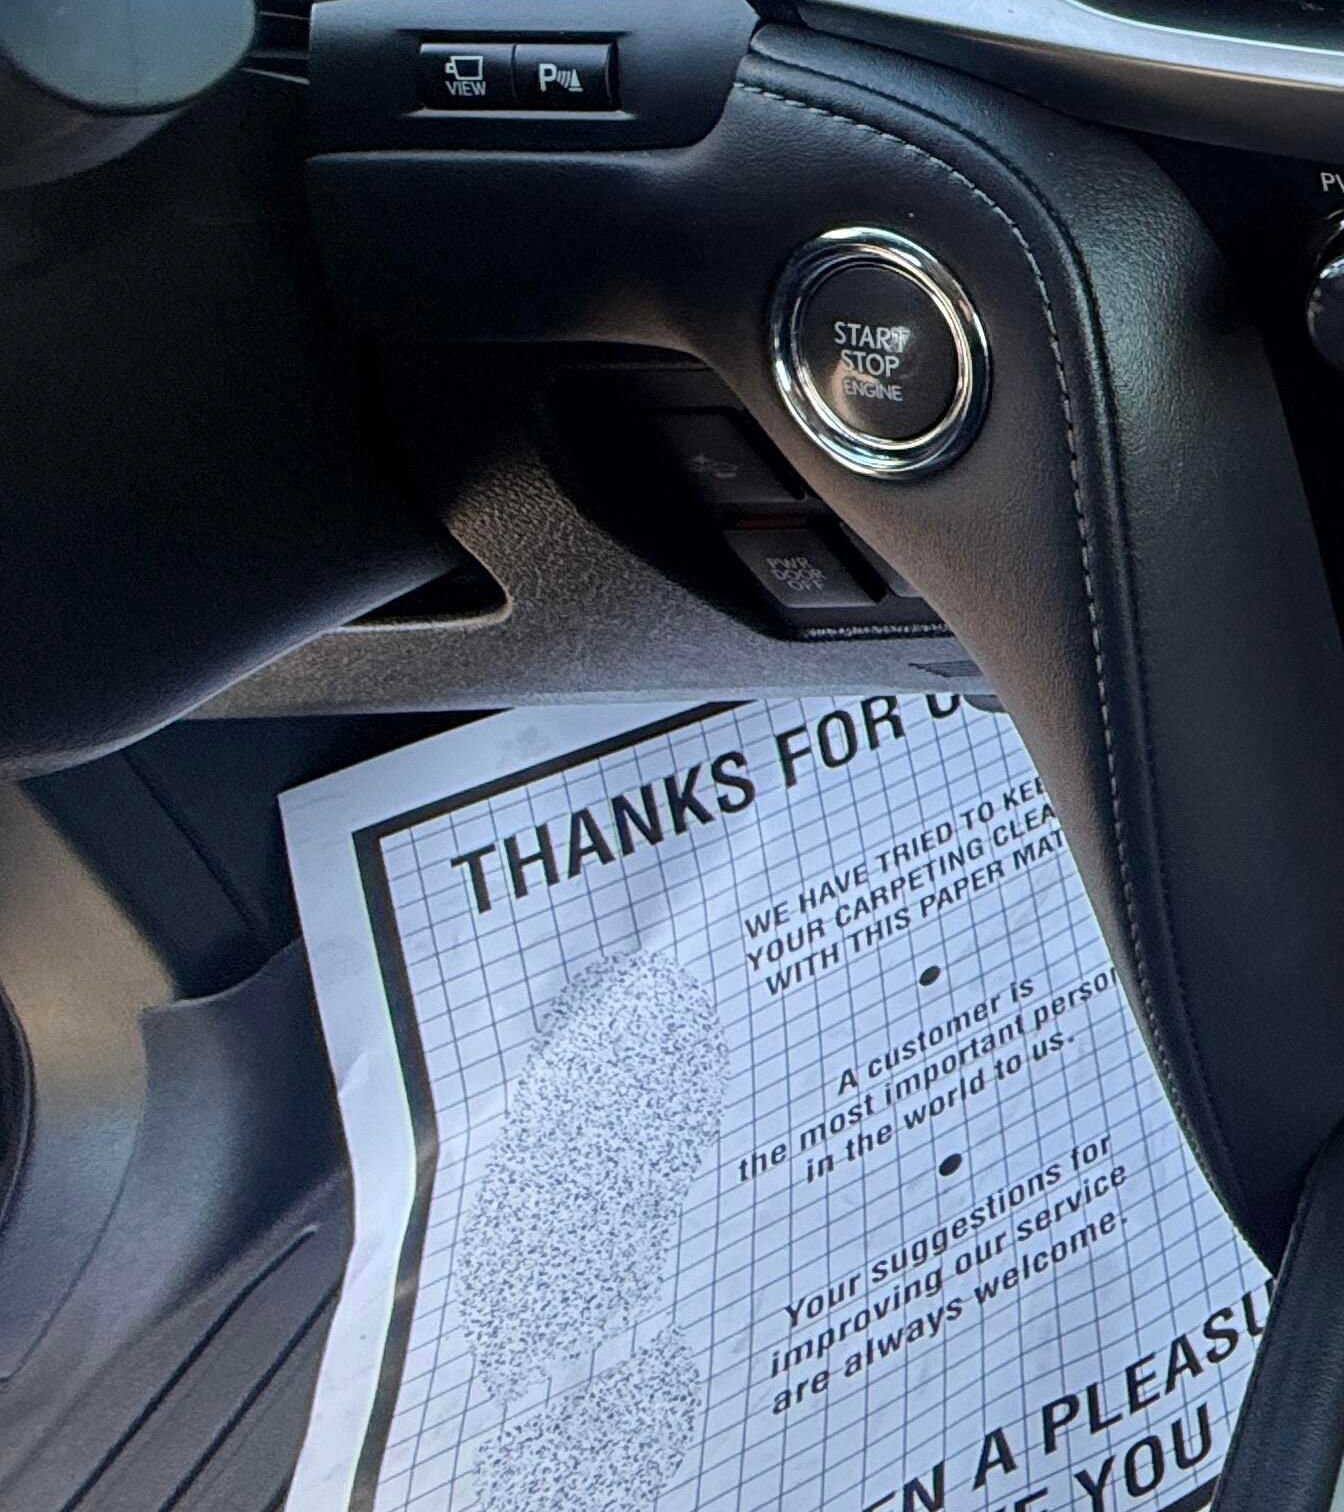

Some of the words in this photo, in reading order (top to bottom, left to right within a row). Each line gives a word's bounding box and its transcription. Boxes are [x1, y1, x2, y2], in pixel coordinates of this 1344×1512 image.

[445, 79, 487, 97] VIEW
[833, 321, 908, 355] START
[840, 349, 901, 378] STOP
[842, 378, 903, 401] ENGINE
[450, 750, 756, 914] THANKS
[774, 695, 906, 789] FOR
[745, 901, 791, 939] WE
[798, 862, 869, 914] HAVE
[875, 821, 954, 874] TRIED
[960, 801, 995, 831] TO
[746, 918, 826, 972] YOUR
[834, 837, 985, 929] CARPETING
[992, 803, 1057, 848] CLEA
[765, 941, 840, 997] WITH
[846, 907, 912, 954] THIS
[919, 860, 1006, 919] PAPER
[1012, 828, 1065, 871] MAT
[738, 1143, 788, 1183] the
[799, 1092, 875, 1152] most
[884, 1014, 1026, 1106] important
[805, 1156, 835, 1184] in
[845, 1122, 893, 1162] the
[903, 1069, 985, 1130] world
[993, 1053, 1022, 1081] to
[1031, 1027, 1076, 1062] us.
[837, 1068, 858, 1096] A
[867, 994, 1003, 1079] customer
[1009, 976, 1035, 1004] is
[770, 1266, 943, 1379] improving
[954, 1231, 1007, 1276] our
[1016, 1164, 1127, 1243] service
[772, 1368, 830, 1416] are
[843, 1296, 964, 1378] always
[972, 1208, 1129, 1306] welcome.
[783, 1272, 862, 1329] Your
[870, 1162, 1062, 1285] suggestions
[1070, 1133, 1113, 1173] for
[972, 1426, 1019, 1492] A
[1040, 1277, 1277, 1457] PLEASU
[1073, 1402, 1214, 1511] YOU
